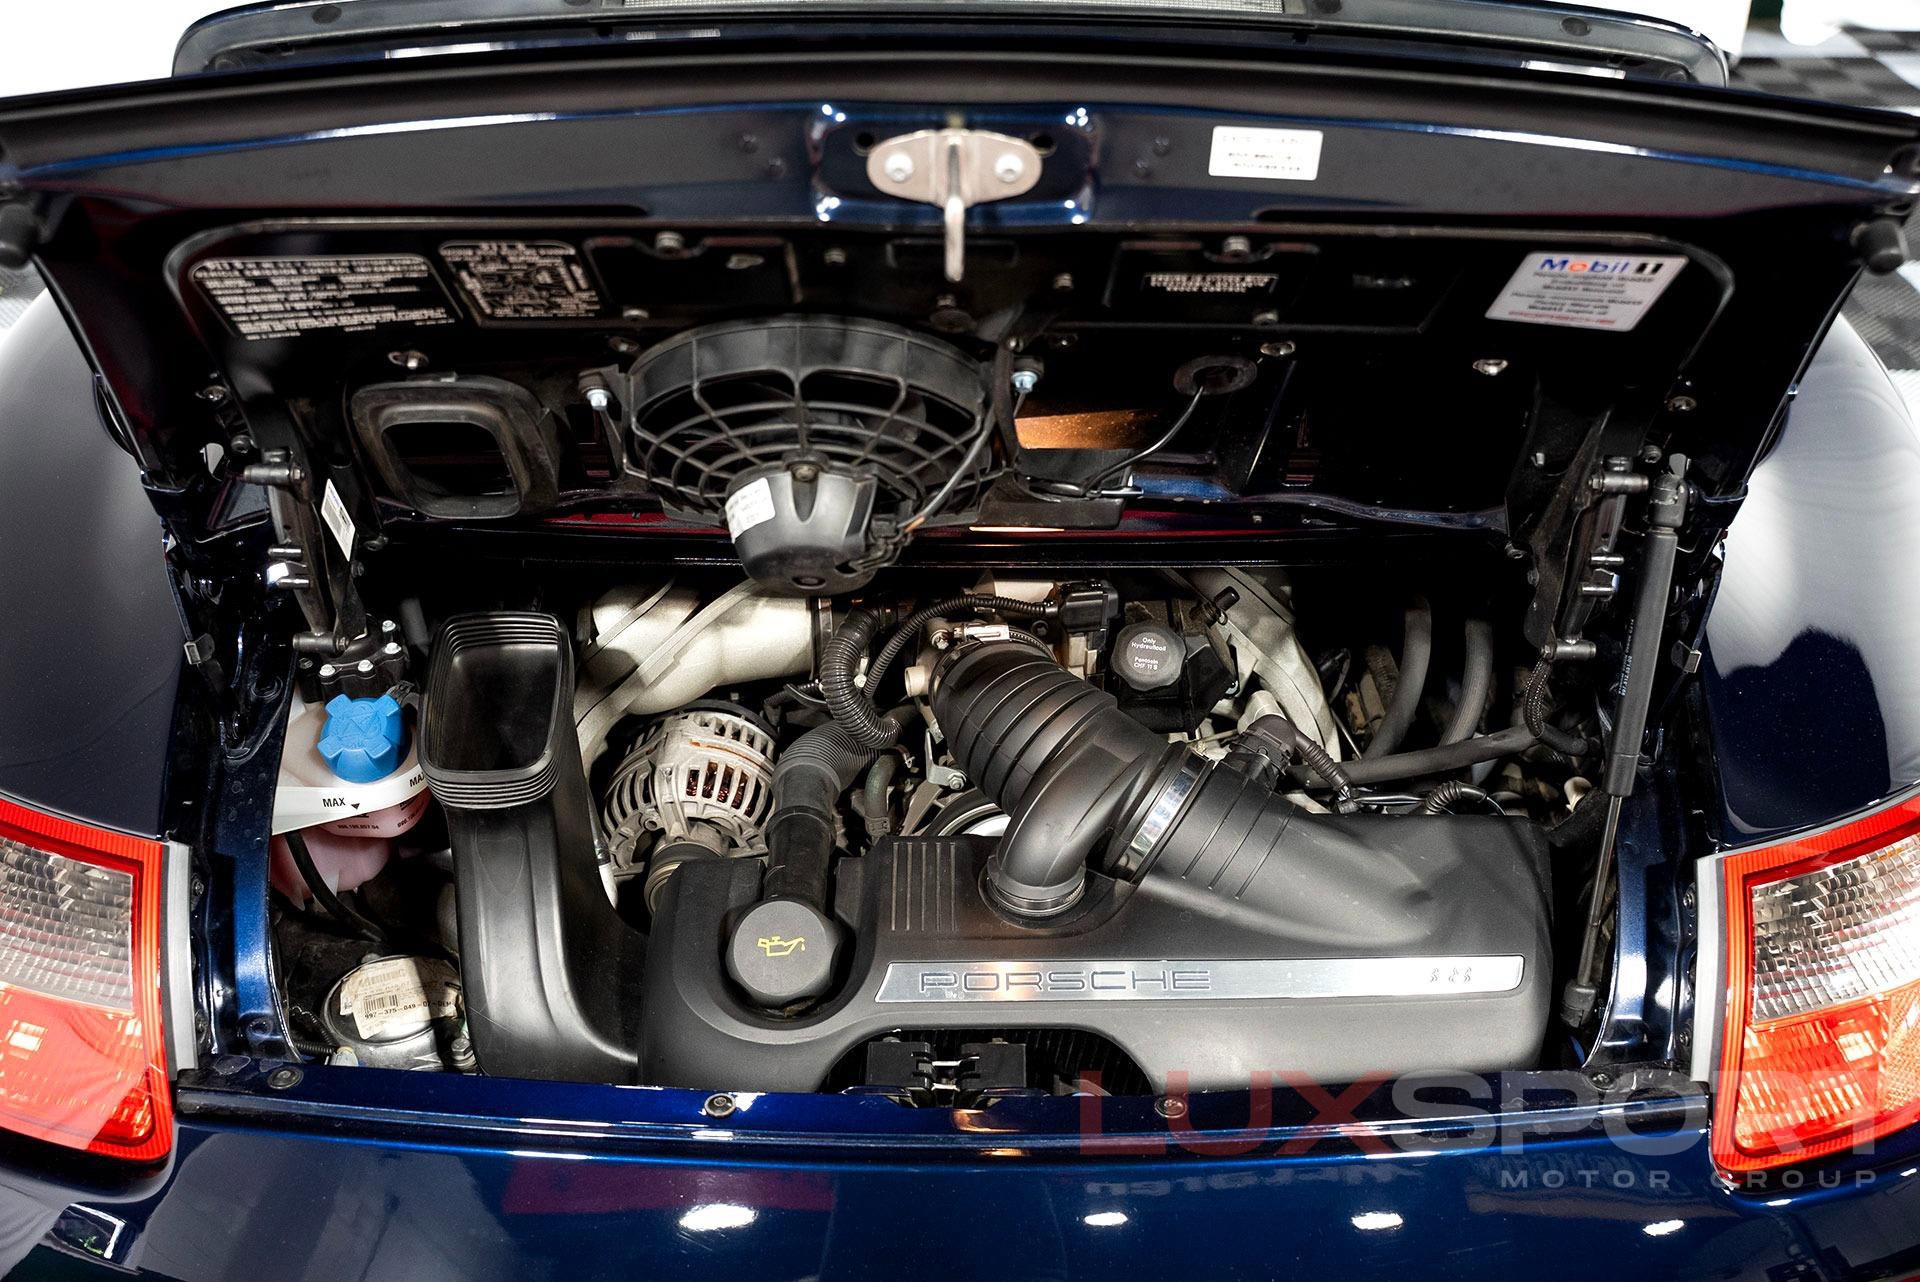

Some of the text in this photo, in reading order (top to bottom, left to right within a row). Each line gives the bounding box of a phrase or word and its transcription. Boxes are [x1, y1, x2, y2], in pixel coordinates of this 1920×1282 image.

[1540, 258, 1629, 273] Mobil
[1142, 637, 1157, 645] Only
[322, 797, 346, 807] MAX
[919, 970, 1211, 992] PORSCHE
